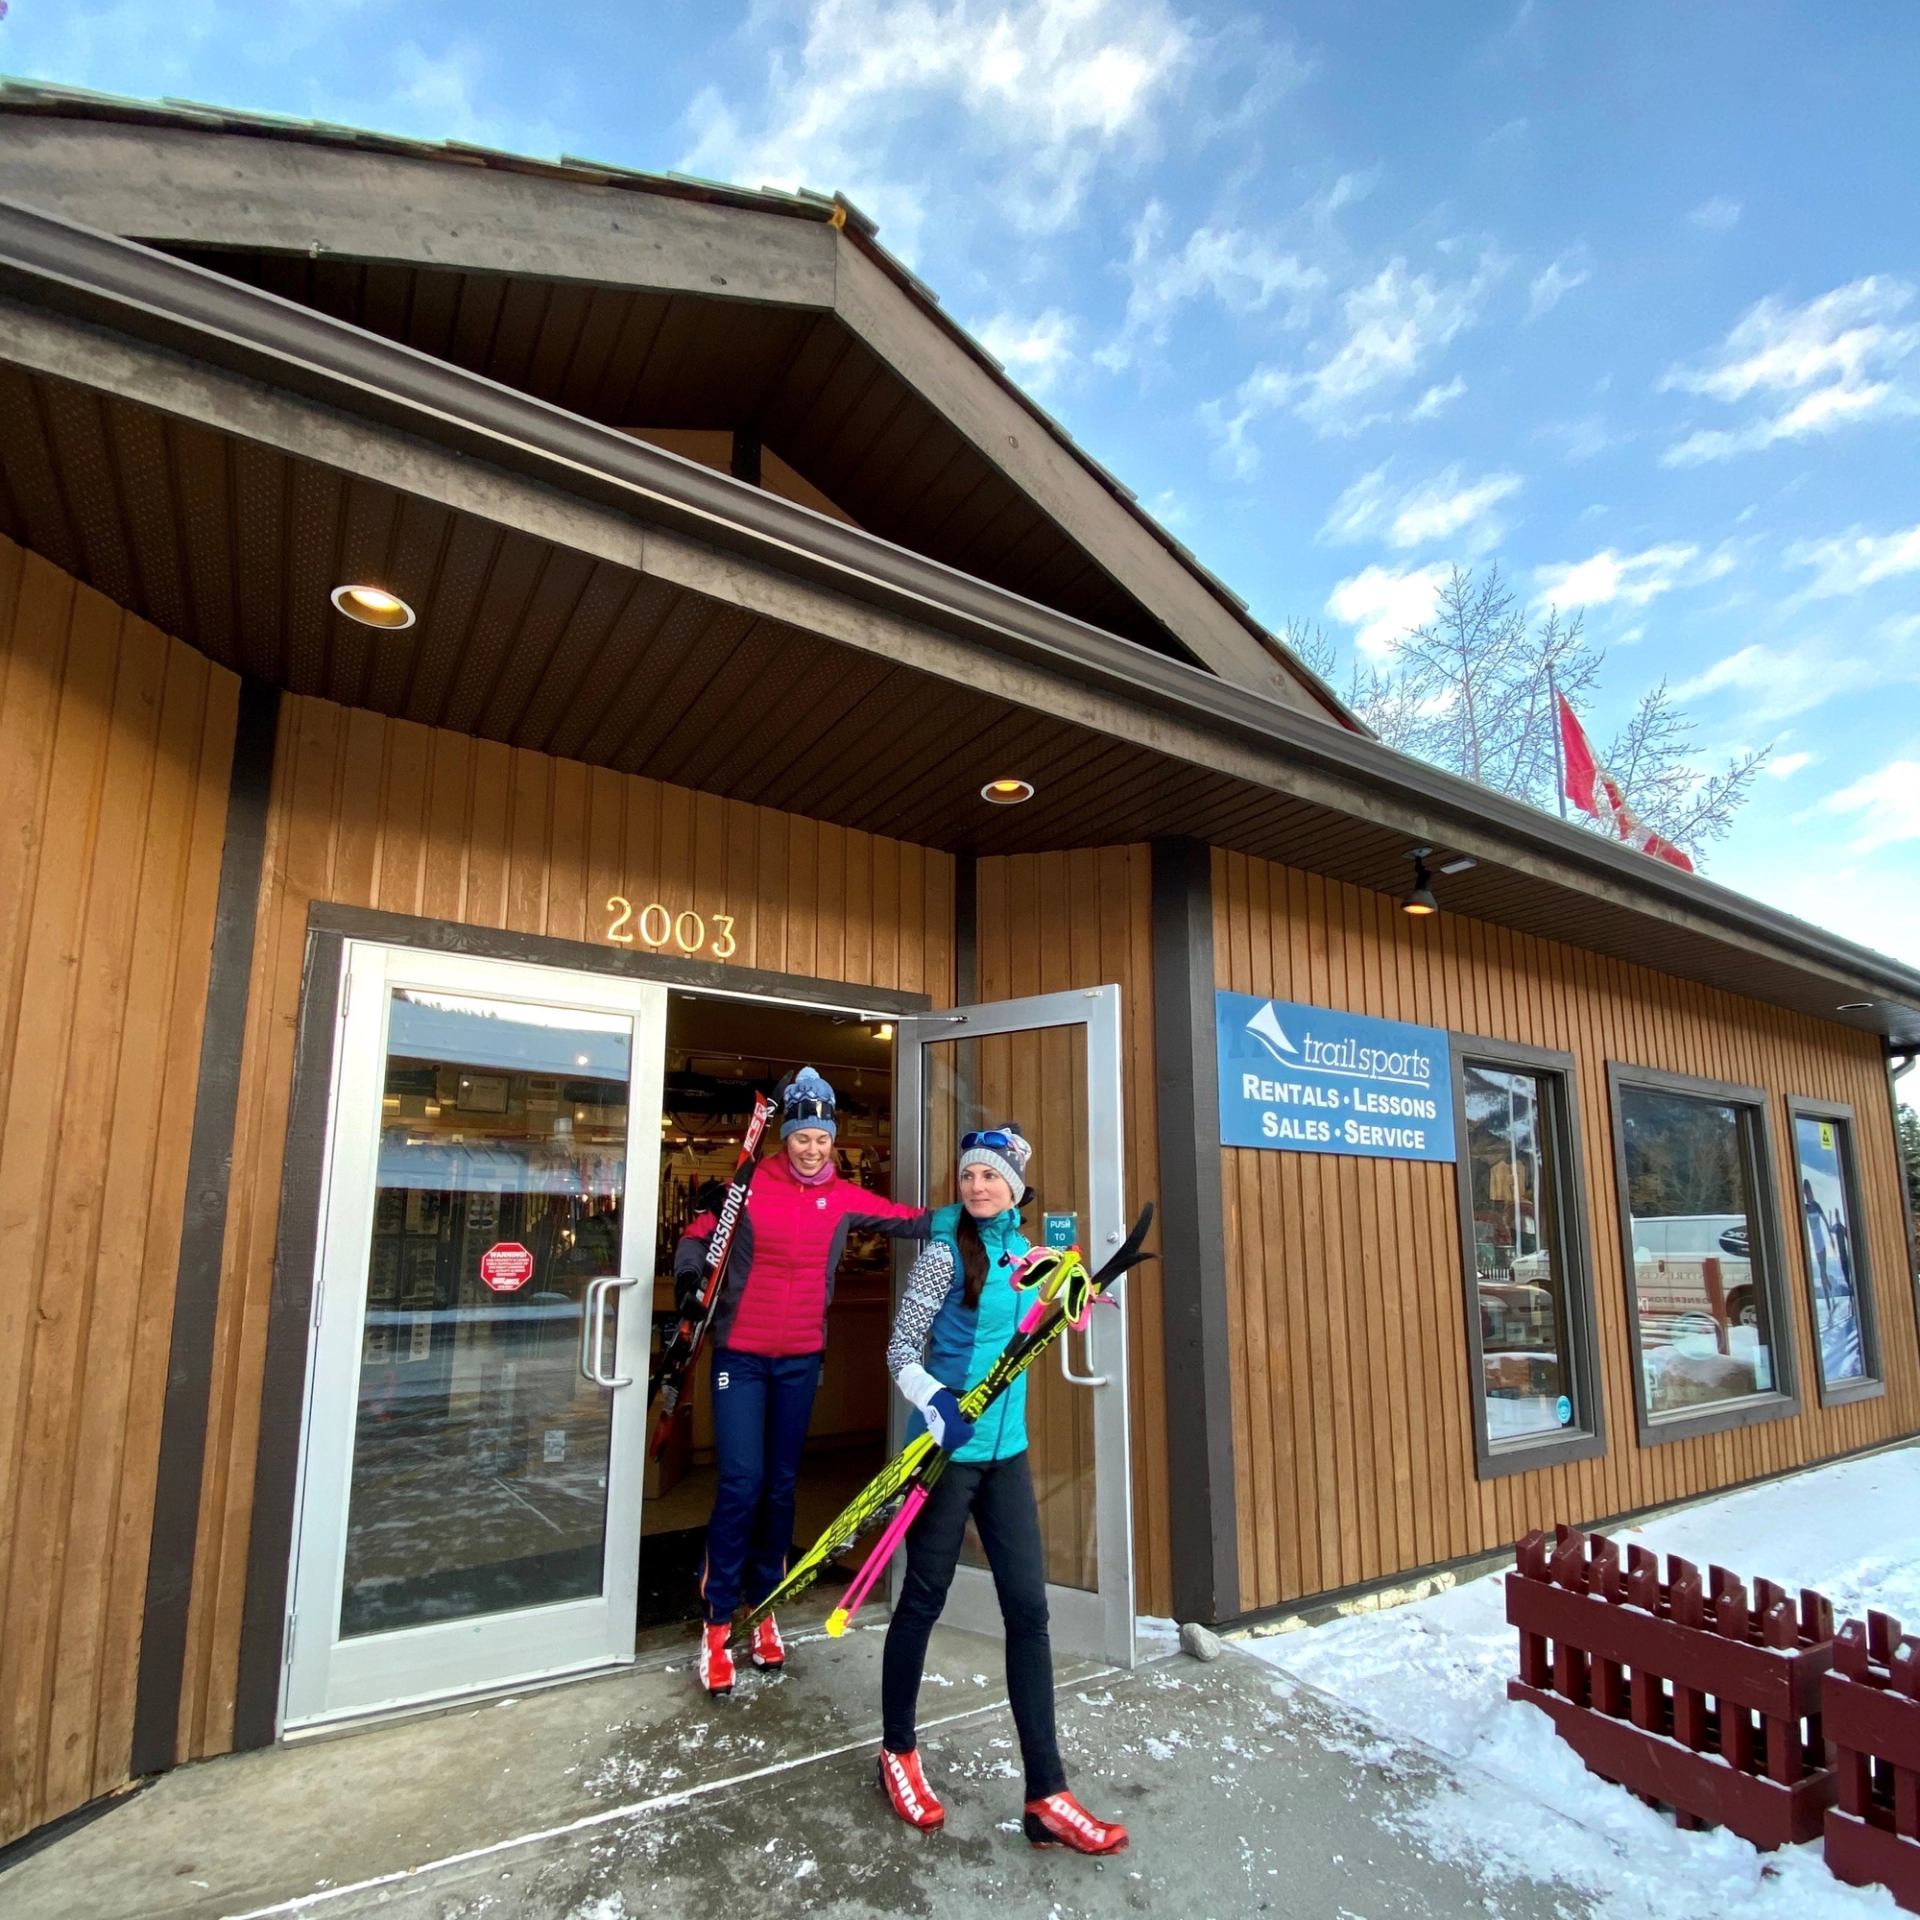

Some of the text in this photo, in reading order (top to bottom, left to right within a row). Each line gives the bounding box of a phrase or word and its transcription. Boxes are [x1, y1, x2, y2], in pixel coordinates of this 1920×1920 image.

[605, 895, 737, 959] 2003
[1303, 1032, 1431, 1080] trailsports
[1242, 1073, 1437, 1120] RENTALS LESSONS
[1262, 1111, 1426, 1150] SALES SERVICE
[705, 1182, 747, 1268] ROSSIGNOL
[1050, 1219, 1071, 1229] PUSH
[1054, 1233, 1066, 1241] TO
[1006, 1317, 1071, 1384] FISCHE
[786, 1569, 818, 1601] RACE
